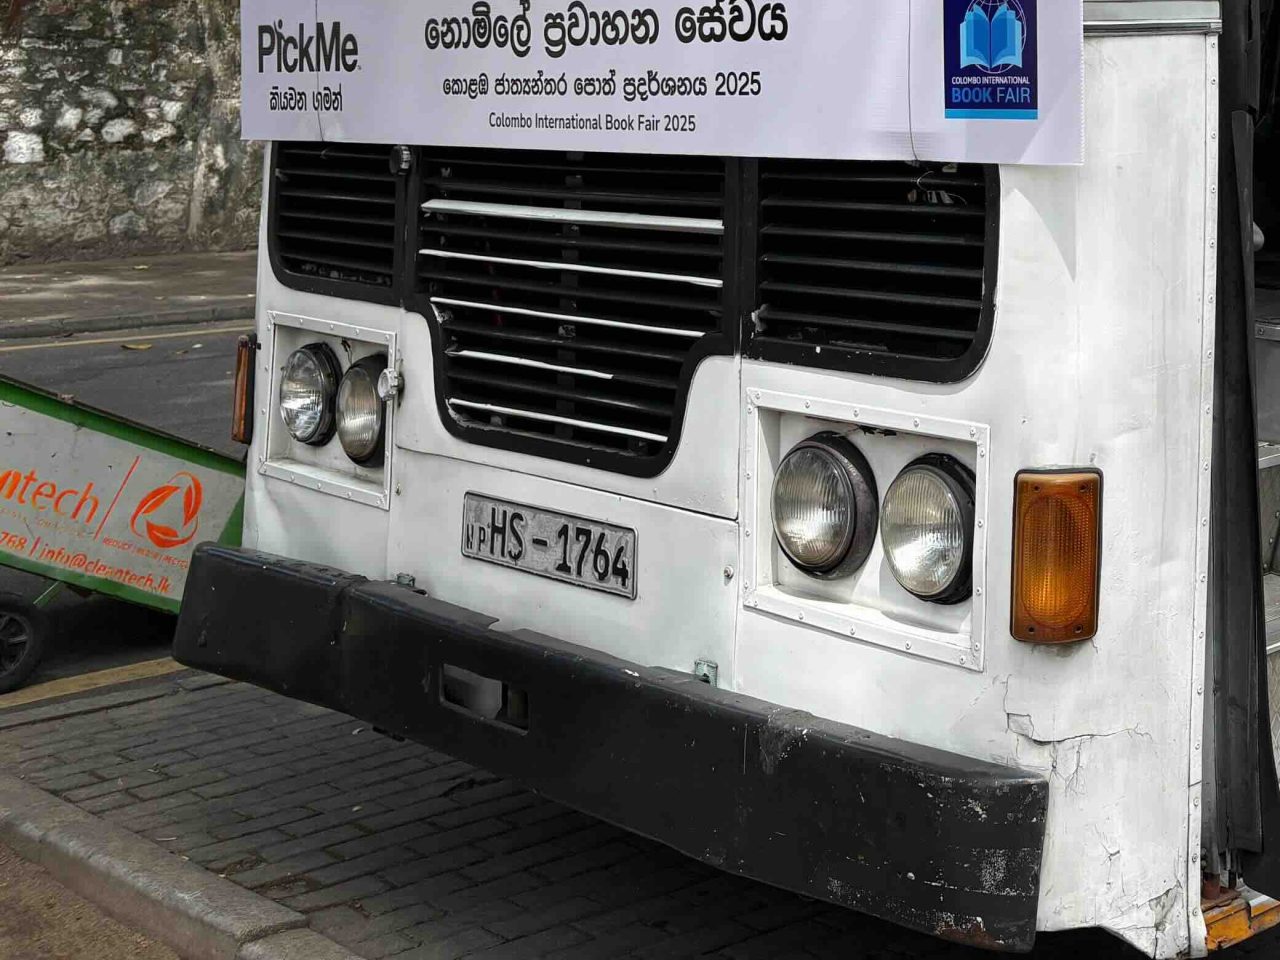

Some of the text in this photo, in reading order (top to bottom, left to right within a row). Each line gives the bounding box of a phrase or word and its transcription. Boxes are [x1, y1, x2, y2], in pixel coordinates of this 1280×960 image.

[257, 19, 359, 74] PickMe
[714, 71, 762, 96] 2025
[951, 76, 1031, 85] COLOMBO INTERNATIONAL
[951, 87, 1031, 104] BOOK FAIR
[489, 112, 696, 132] Colombo International Book Fair 2025
